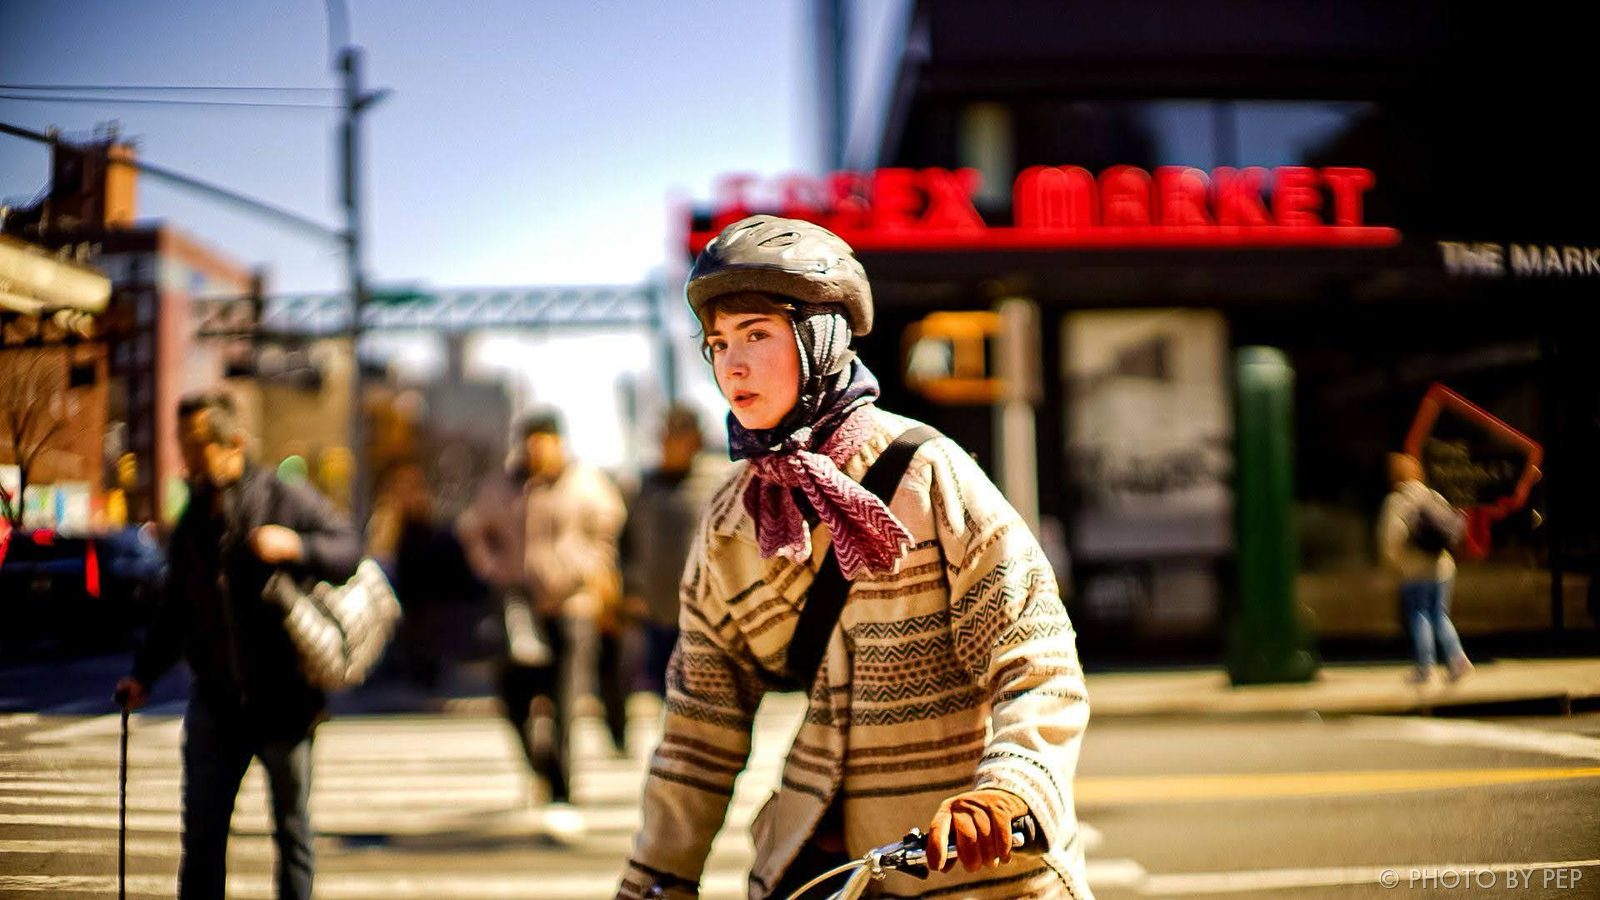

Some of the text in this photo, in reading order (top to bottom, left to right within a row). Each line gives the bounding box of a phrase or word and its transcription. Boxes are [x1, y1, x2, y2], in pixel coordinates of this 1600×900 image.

[1011, 164, 1375, 227] MARKET
[1438, 241, 1600, 275] THE MARK
